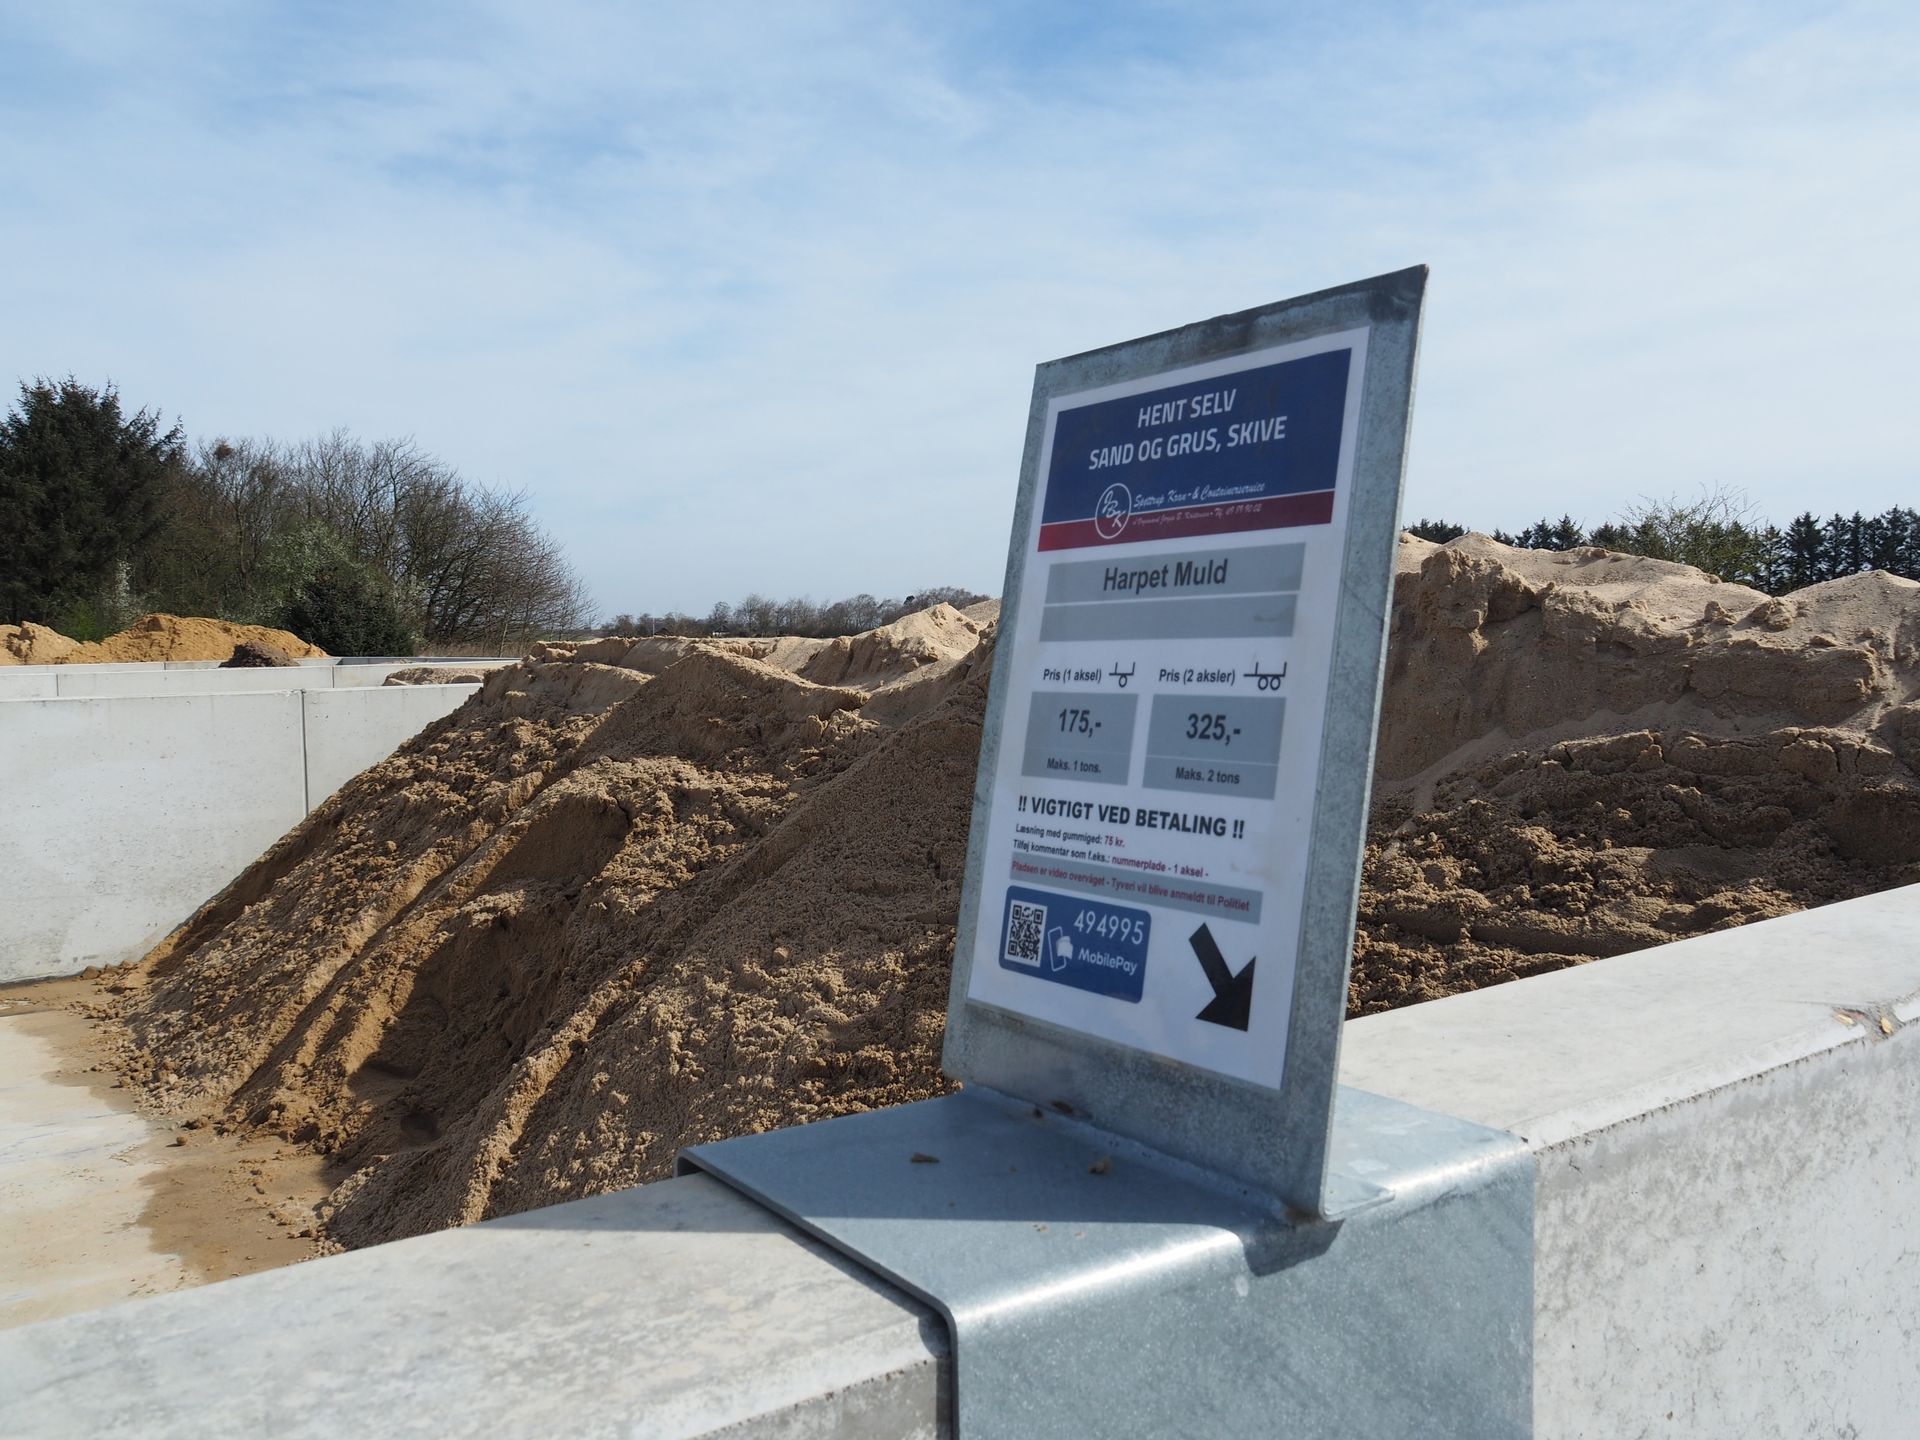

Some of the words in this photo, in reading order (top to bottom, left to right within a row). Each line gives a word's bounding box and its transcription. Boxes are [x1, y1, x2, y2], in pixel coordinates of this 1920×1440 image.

[1138, 399, 1187, 428] HENT
[1190, 388, 1237, 418] SELV
[1089, 443, 1134, 470] SAND
[1138, 438, 1164, 462] OG
[1167, 428, 1222, 457] GRUS,
[1227, 416, 1288, 447] SKIVE
[1103, 563, 1169, 595] Harpet
[1174, 558, 1228, 587] Muld
[1043, 668, 1061, 681] Pris
[1063, 668, 1072, 683] (1
[1074, 668, 1102, 684] aksel)
[1159, 668, 1180, 682] Pris
[1183, 668, 1194, 685] (2
[1196, 669, 1235, 686] aksler)
[1059, 708, 1102, 738] 175,-
[1186, 713, 1241, 746] 325,-
[1047, 757, 1070, 771] Maks.
[1080, 761, 1101, 773] tons.
[1175, 766, 1204, 781] Maks.
[1207, 769, 1214, 782] 2
[1216, 771, 1241, 784] tons
[1018, 795, 1027, 812] !!
[1032, 797, 1093, 820] VIGTIGT
[1098, 804, 1130, 825] VED
[1135, 808, 1227, 837] BETALING
[1233, 819, 1245, 839] !!
[1015, 823, 1045, 838] Læsning
[1046, 829, 1061, 838] med
[1062, 831, 1103, 845] gummiged:
[1104, 835, 1114, 846] 75
[1115, 837, 1126, 847] kr.
[1014, 839, 1029, 852] Tilføj
[1031, 842, 1070, 857] kommentar
[1070, 850, 1086, 859] som
[1111, 855, 1166, 872] nummerplade
[1180, 865, 1204, 878] aksel
[1012, 860, 1039, 874] Pladsen
[1048, 868, 1068, 879] video
[1069, 872, 1106, 888] overvåget
[1112, 877, 1136, 891] Tyveri
[1137, 884, 1147, 893] vil
[1148, 885, 1169, 898] blive
[1170, 888, 1205, 904] anmeldt
[1207, 893, 1216, 903] til
[1218, 895, 1251, 912] Politiet
[1073, 909, 1144, 946] 494995
[1078, 948, 1138, 977] MobilePay
